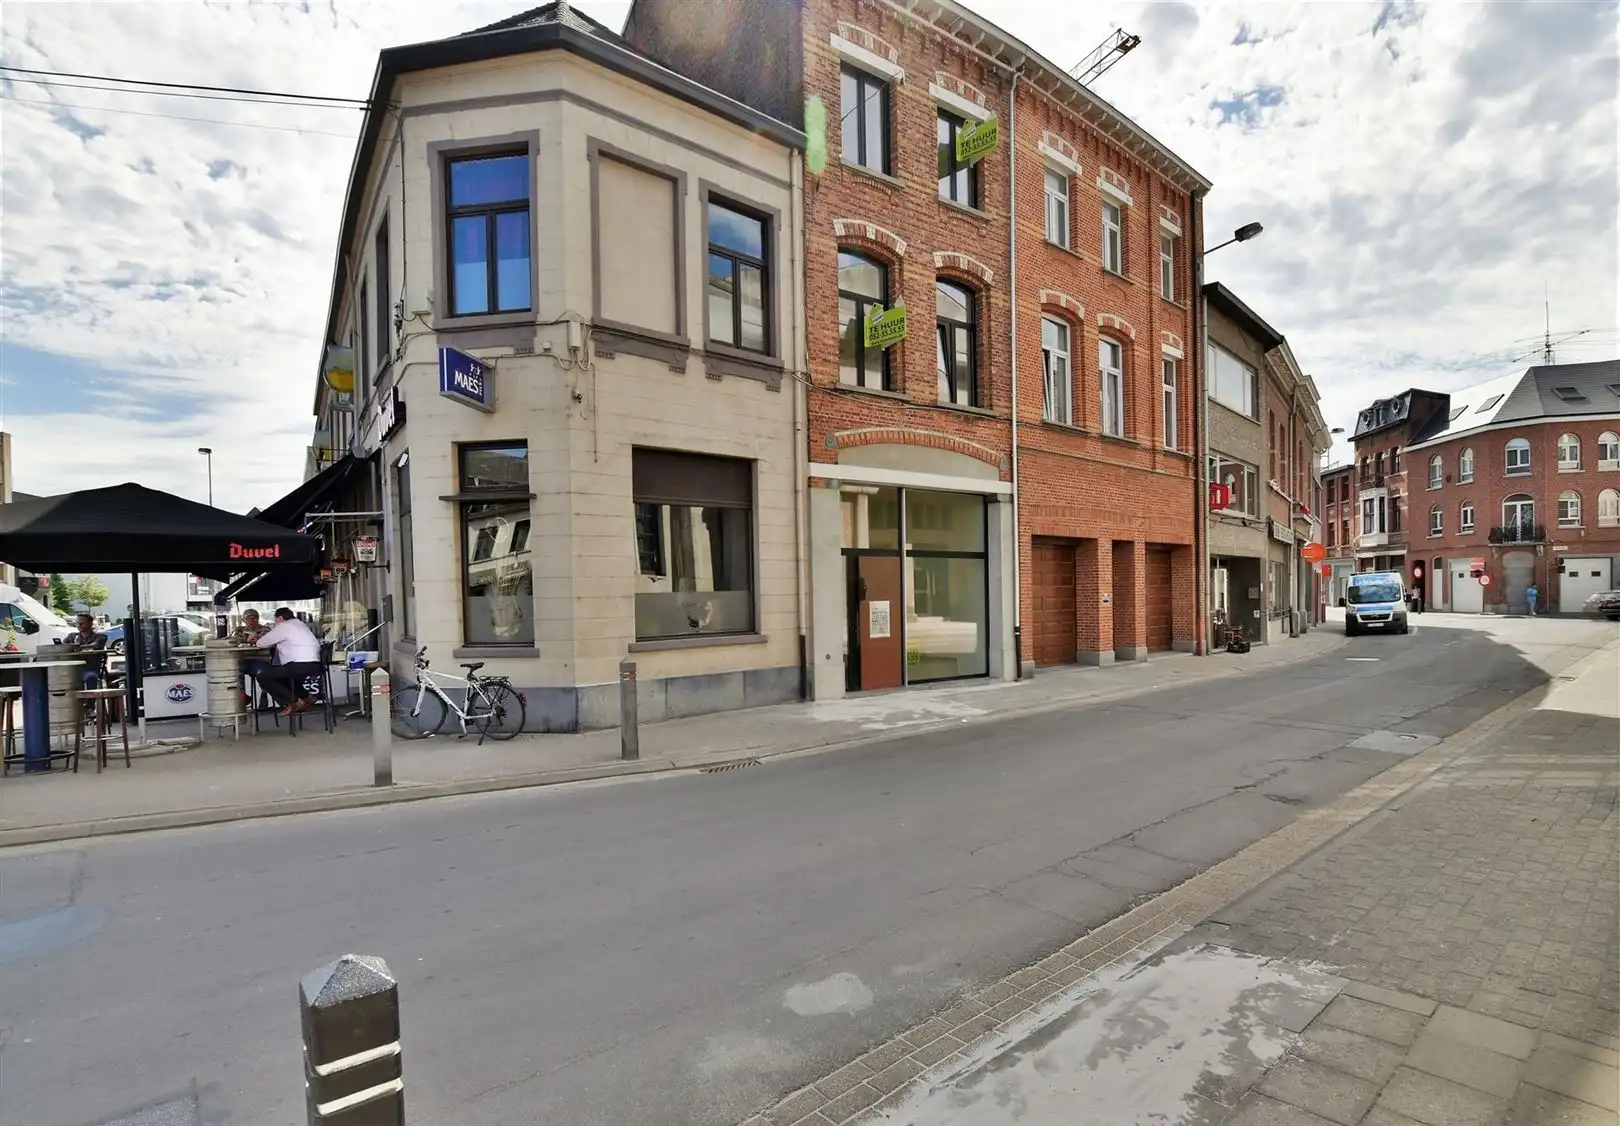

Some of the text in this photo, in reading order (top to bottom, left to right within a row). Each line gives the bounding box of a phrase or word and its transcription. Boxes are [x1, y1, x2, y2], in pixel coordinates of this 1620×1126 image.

[961, 140, 969, 148] TE
[972, 128, 997, 143] HUUR
[869, 325, 878, 333] TE
[880, 317, 905, 330] HUUR
[454, 370, 479, 394] MAES
[229, 542, 280, 559] Duvel
[167, 688, 193, 698] MAES
